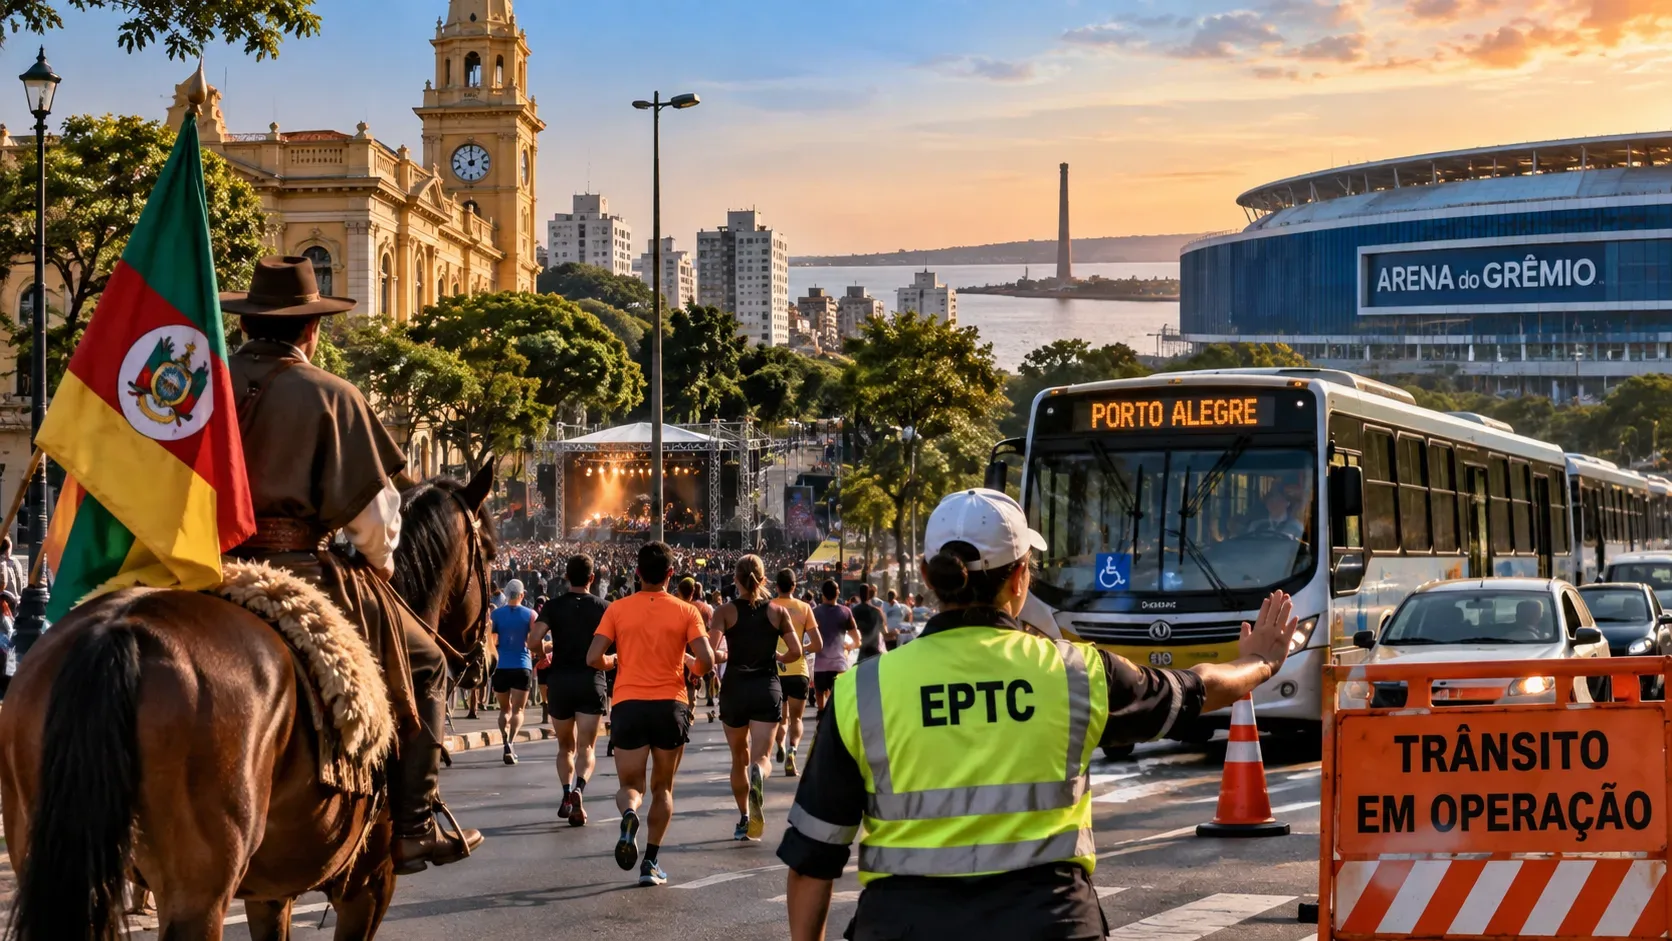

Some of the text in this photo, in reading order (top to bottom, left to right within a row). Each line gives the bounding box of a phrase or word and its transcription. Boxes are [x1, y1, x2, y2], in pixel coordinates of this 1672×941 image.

[1376, 254, 1597, 293] ARENA do GRÊMIO
[1091, 398, 1258, 429] PORTO ALEGRE
[920, 678, 1036, 728] EPTC
[1394, 723, 1609, 773] TRÂNSITO
[1357, 781, 1653, 842] EM OPERAÇÃO
